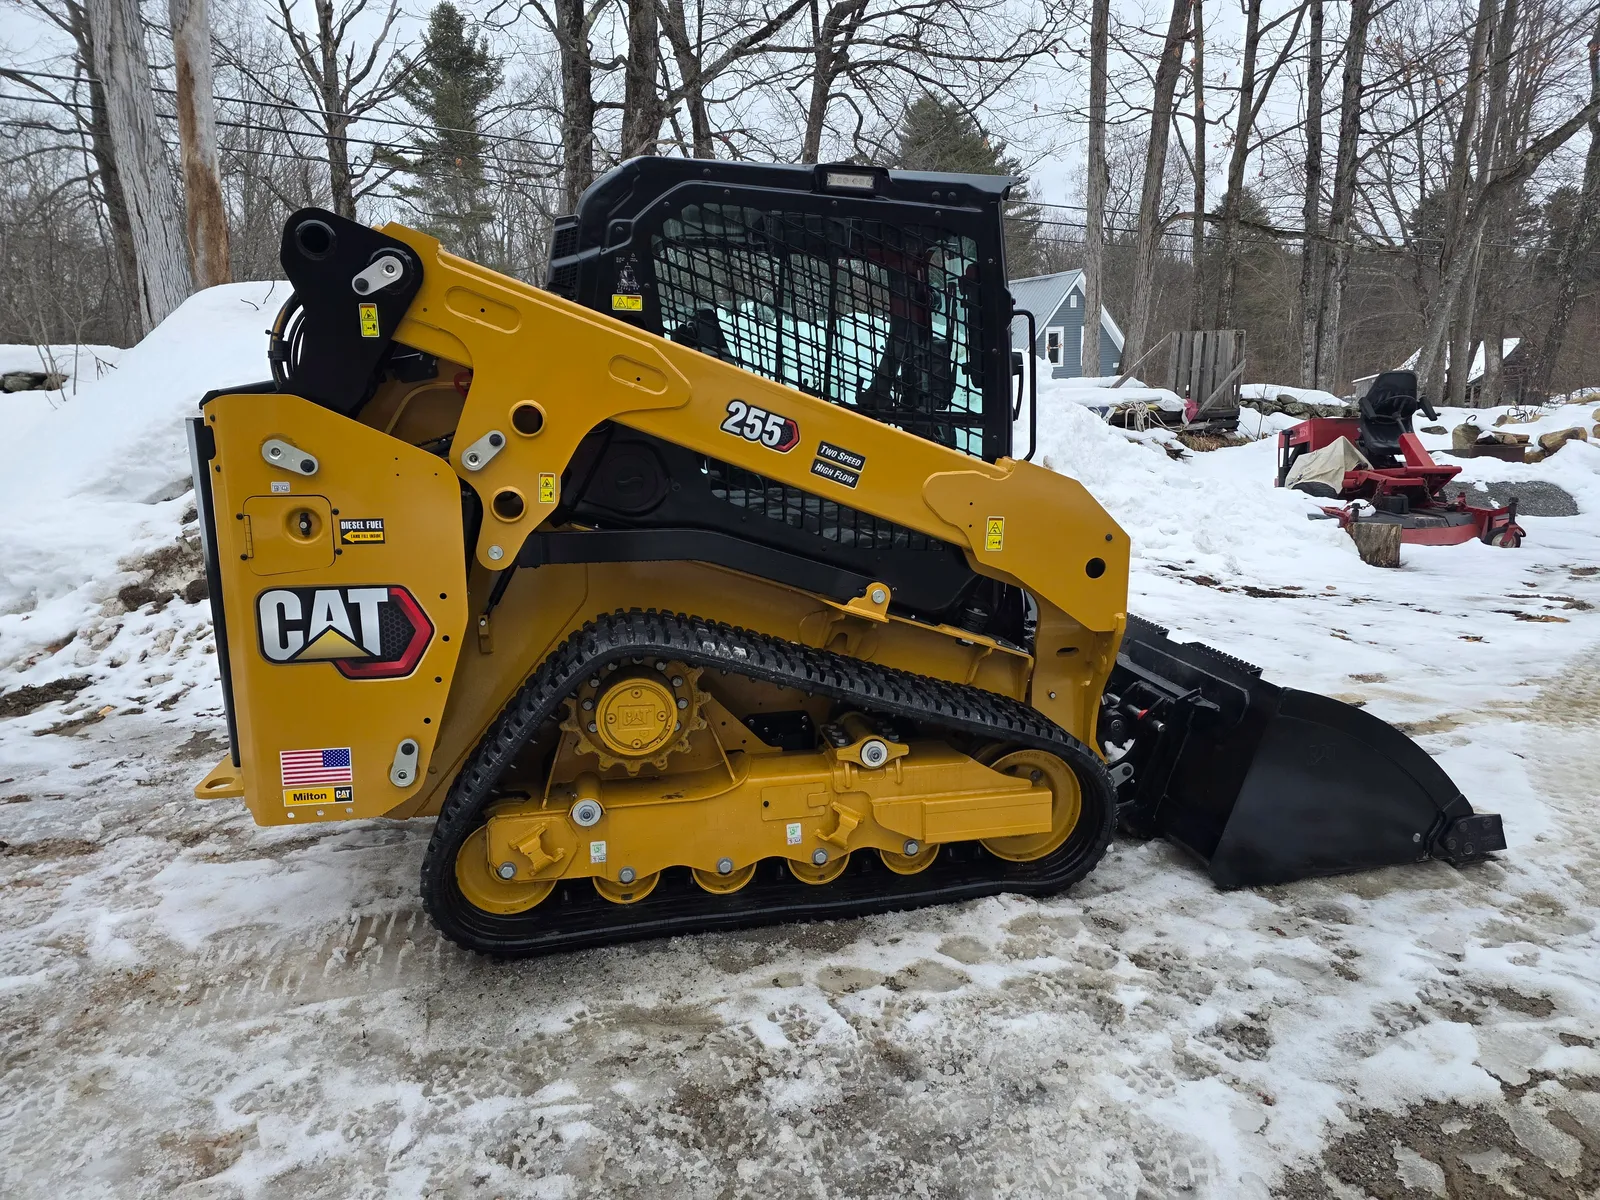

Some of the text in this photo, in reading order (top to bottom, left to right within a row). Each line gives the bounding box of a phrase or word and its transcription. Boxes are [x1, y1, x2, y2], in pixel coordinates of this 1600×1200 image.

[722, 400, 785, 446] 255
[341, 520, 383, 529] DIESEL FUEL
[259, 588, 388, 661] CAT
[293, 790, 350, 801] Milton CAT
